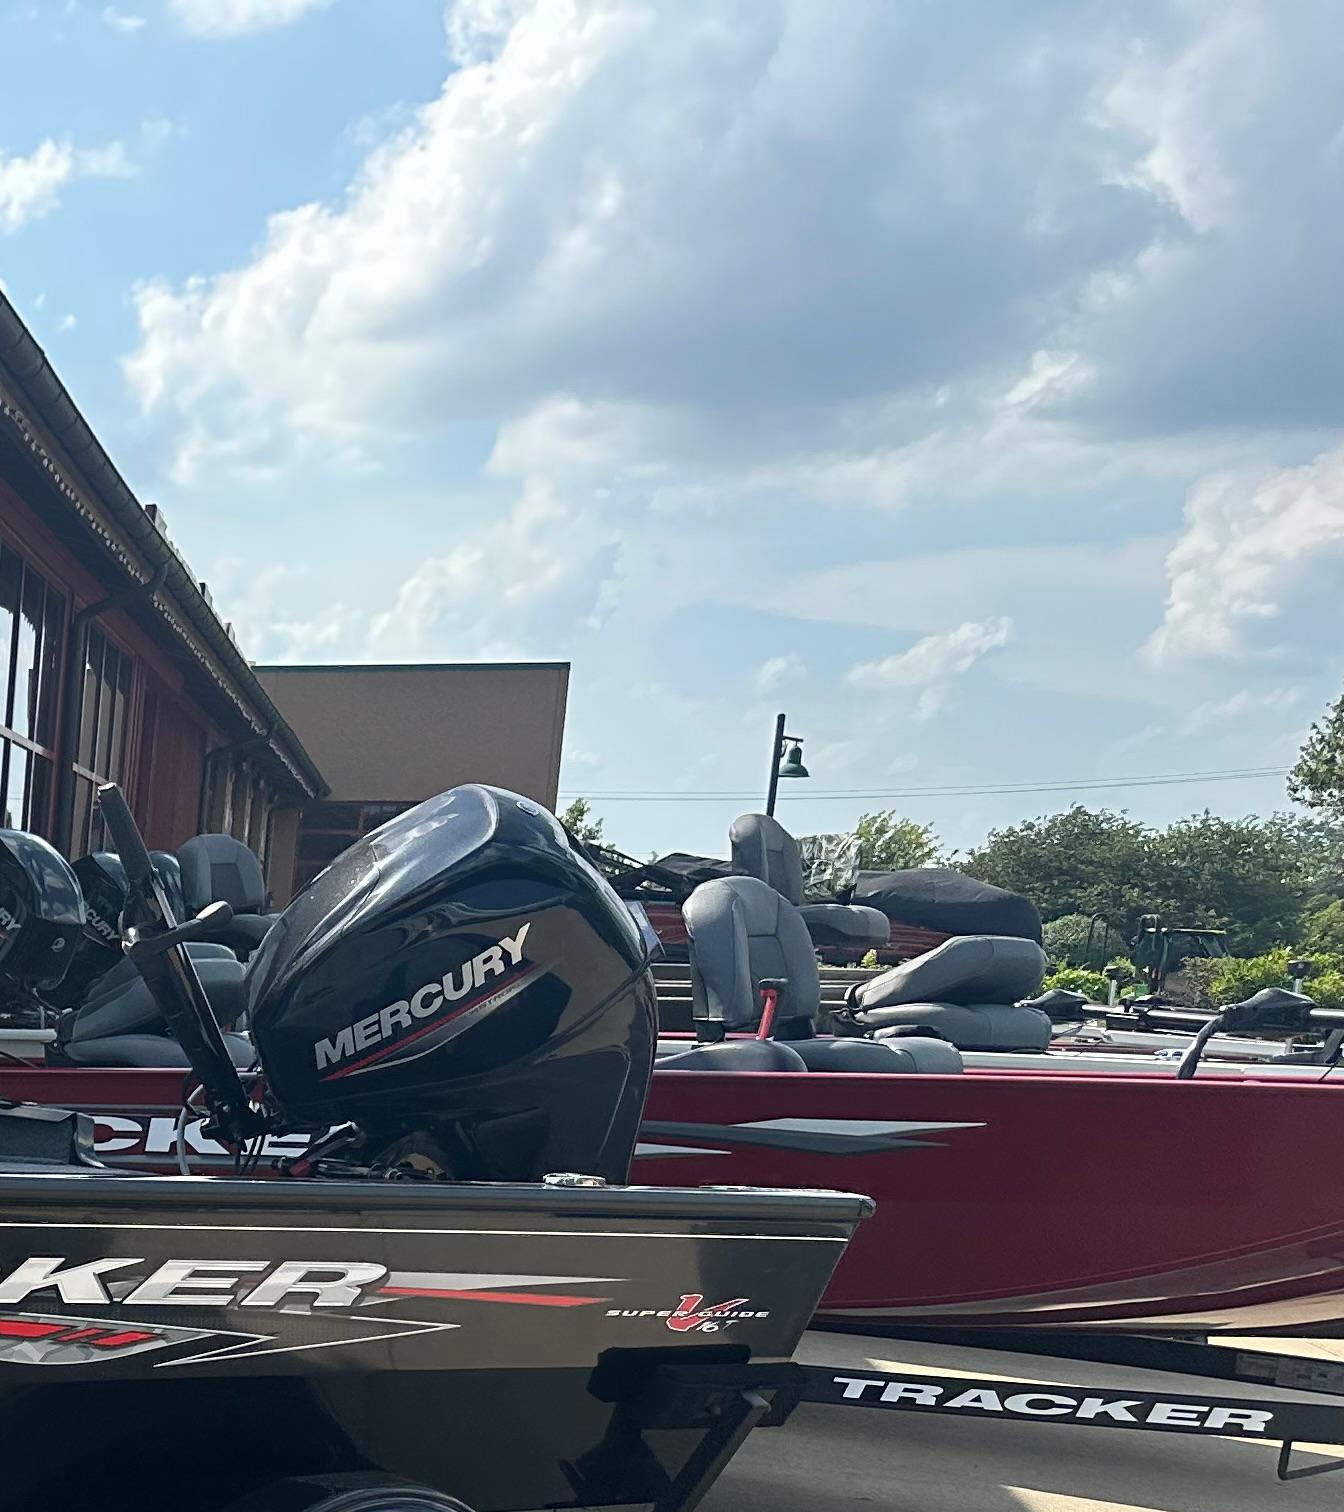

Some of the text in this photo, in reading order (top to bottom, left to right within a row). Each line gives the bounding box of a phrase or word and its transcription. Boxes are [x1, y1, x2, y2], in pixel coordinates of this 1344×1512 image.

[314, 921, 532, 1071] MERCURY
[604, 1309, 689, 1318] SUPER
[696, 1310, 771, 1319] GUIDE
[833, 1376, 1275, 1433] TRACKER
